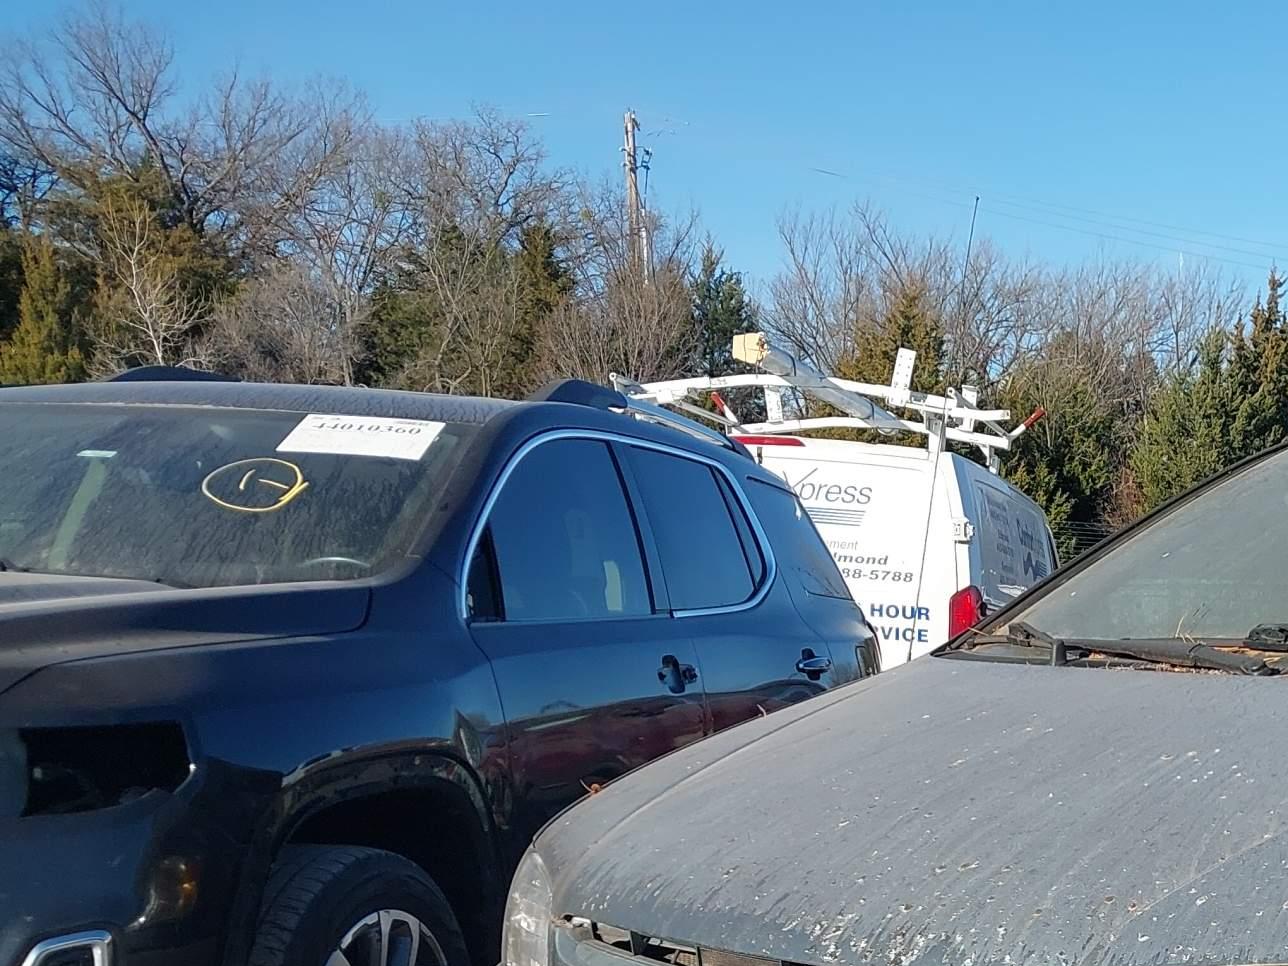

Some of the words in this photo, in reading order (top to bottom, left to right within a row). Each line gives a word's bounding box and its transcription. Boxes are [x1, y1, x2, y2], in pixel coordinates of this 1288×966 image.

[312, 422, 421, 434] 44010360
[827, 540, 858, 550] ment
[833, 551, 889, 566] mond
[869, 603, 931, 621] HOUR
